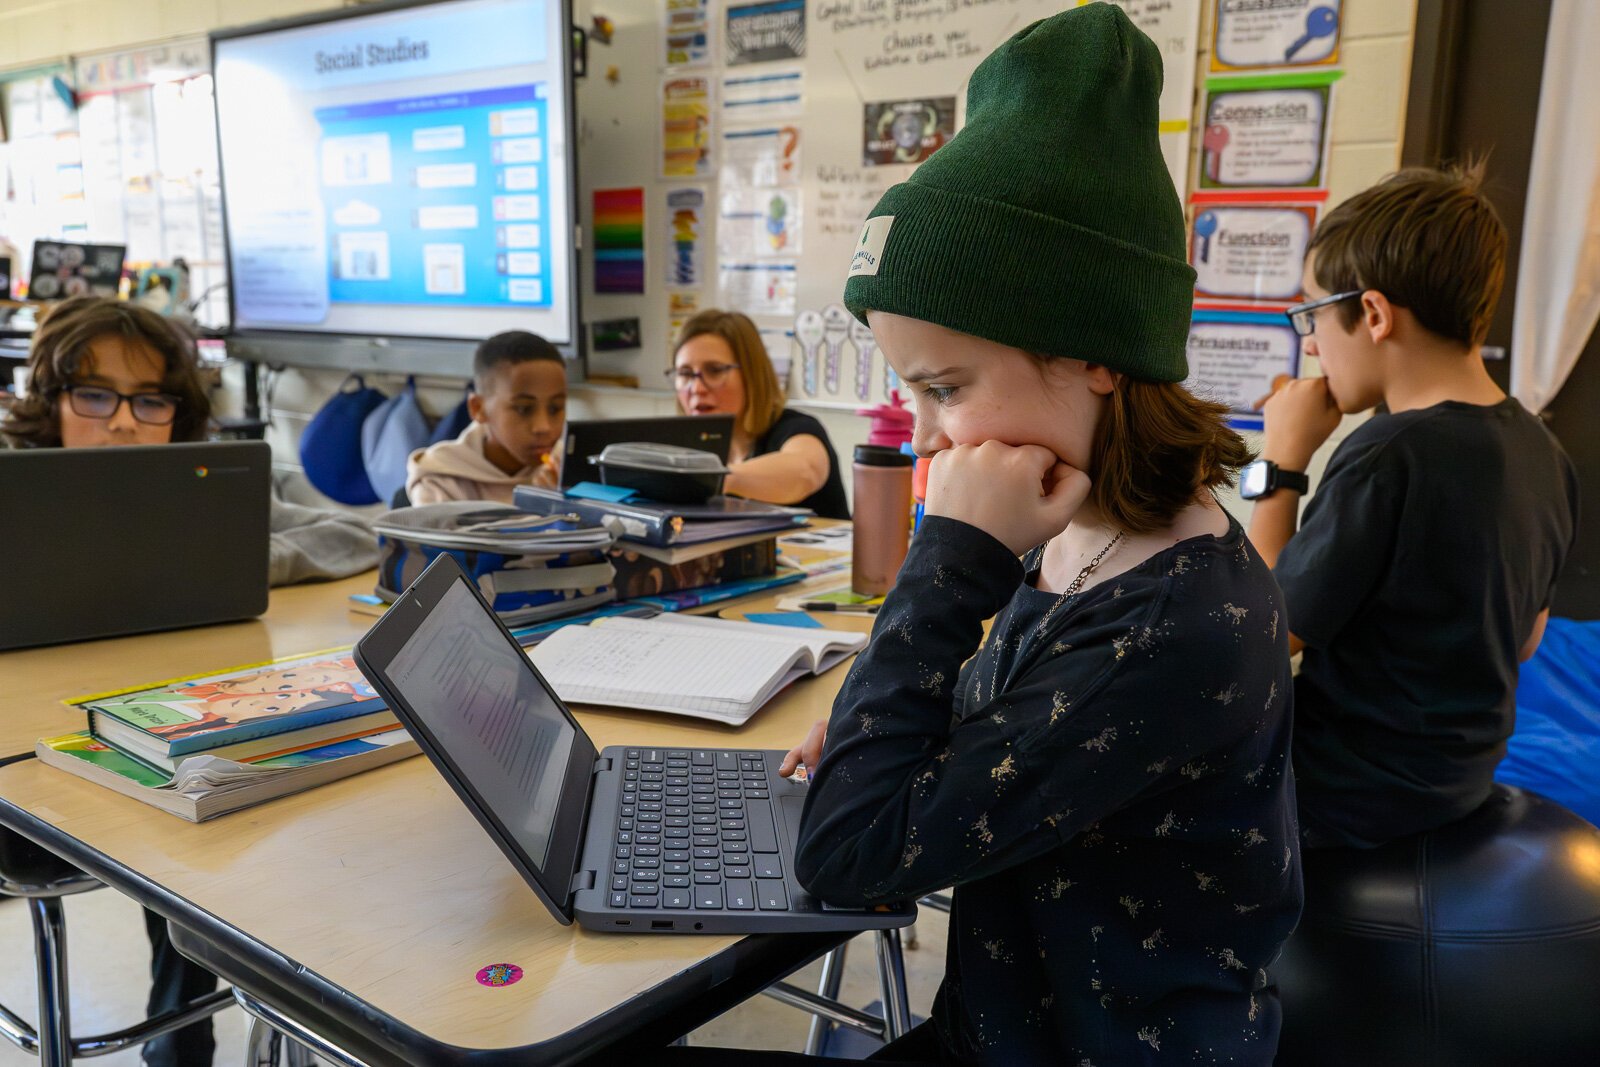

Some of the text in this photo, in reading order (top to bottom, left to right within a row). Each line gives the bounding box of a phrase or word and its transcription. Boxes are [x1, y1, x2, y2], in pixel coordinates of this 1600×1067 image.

[314, 36, 430, 74] Social Studies
[1212, 101, 1308, 120] Connection
[1218, 229, 1291, 247] Function
[1189, 334, 1271, 351] Perspective
